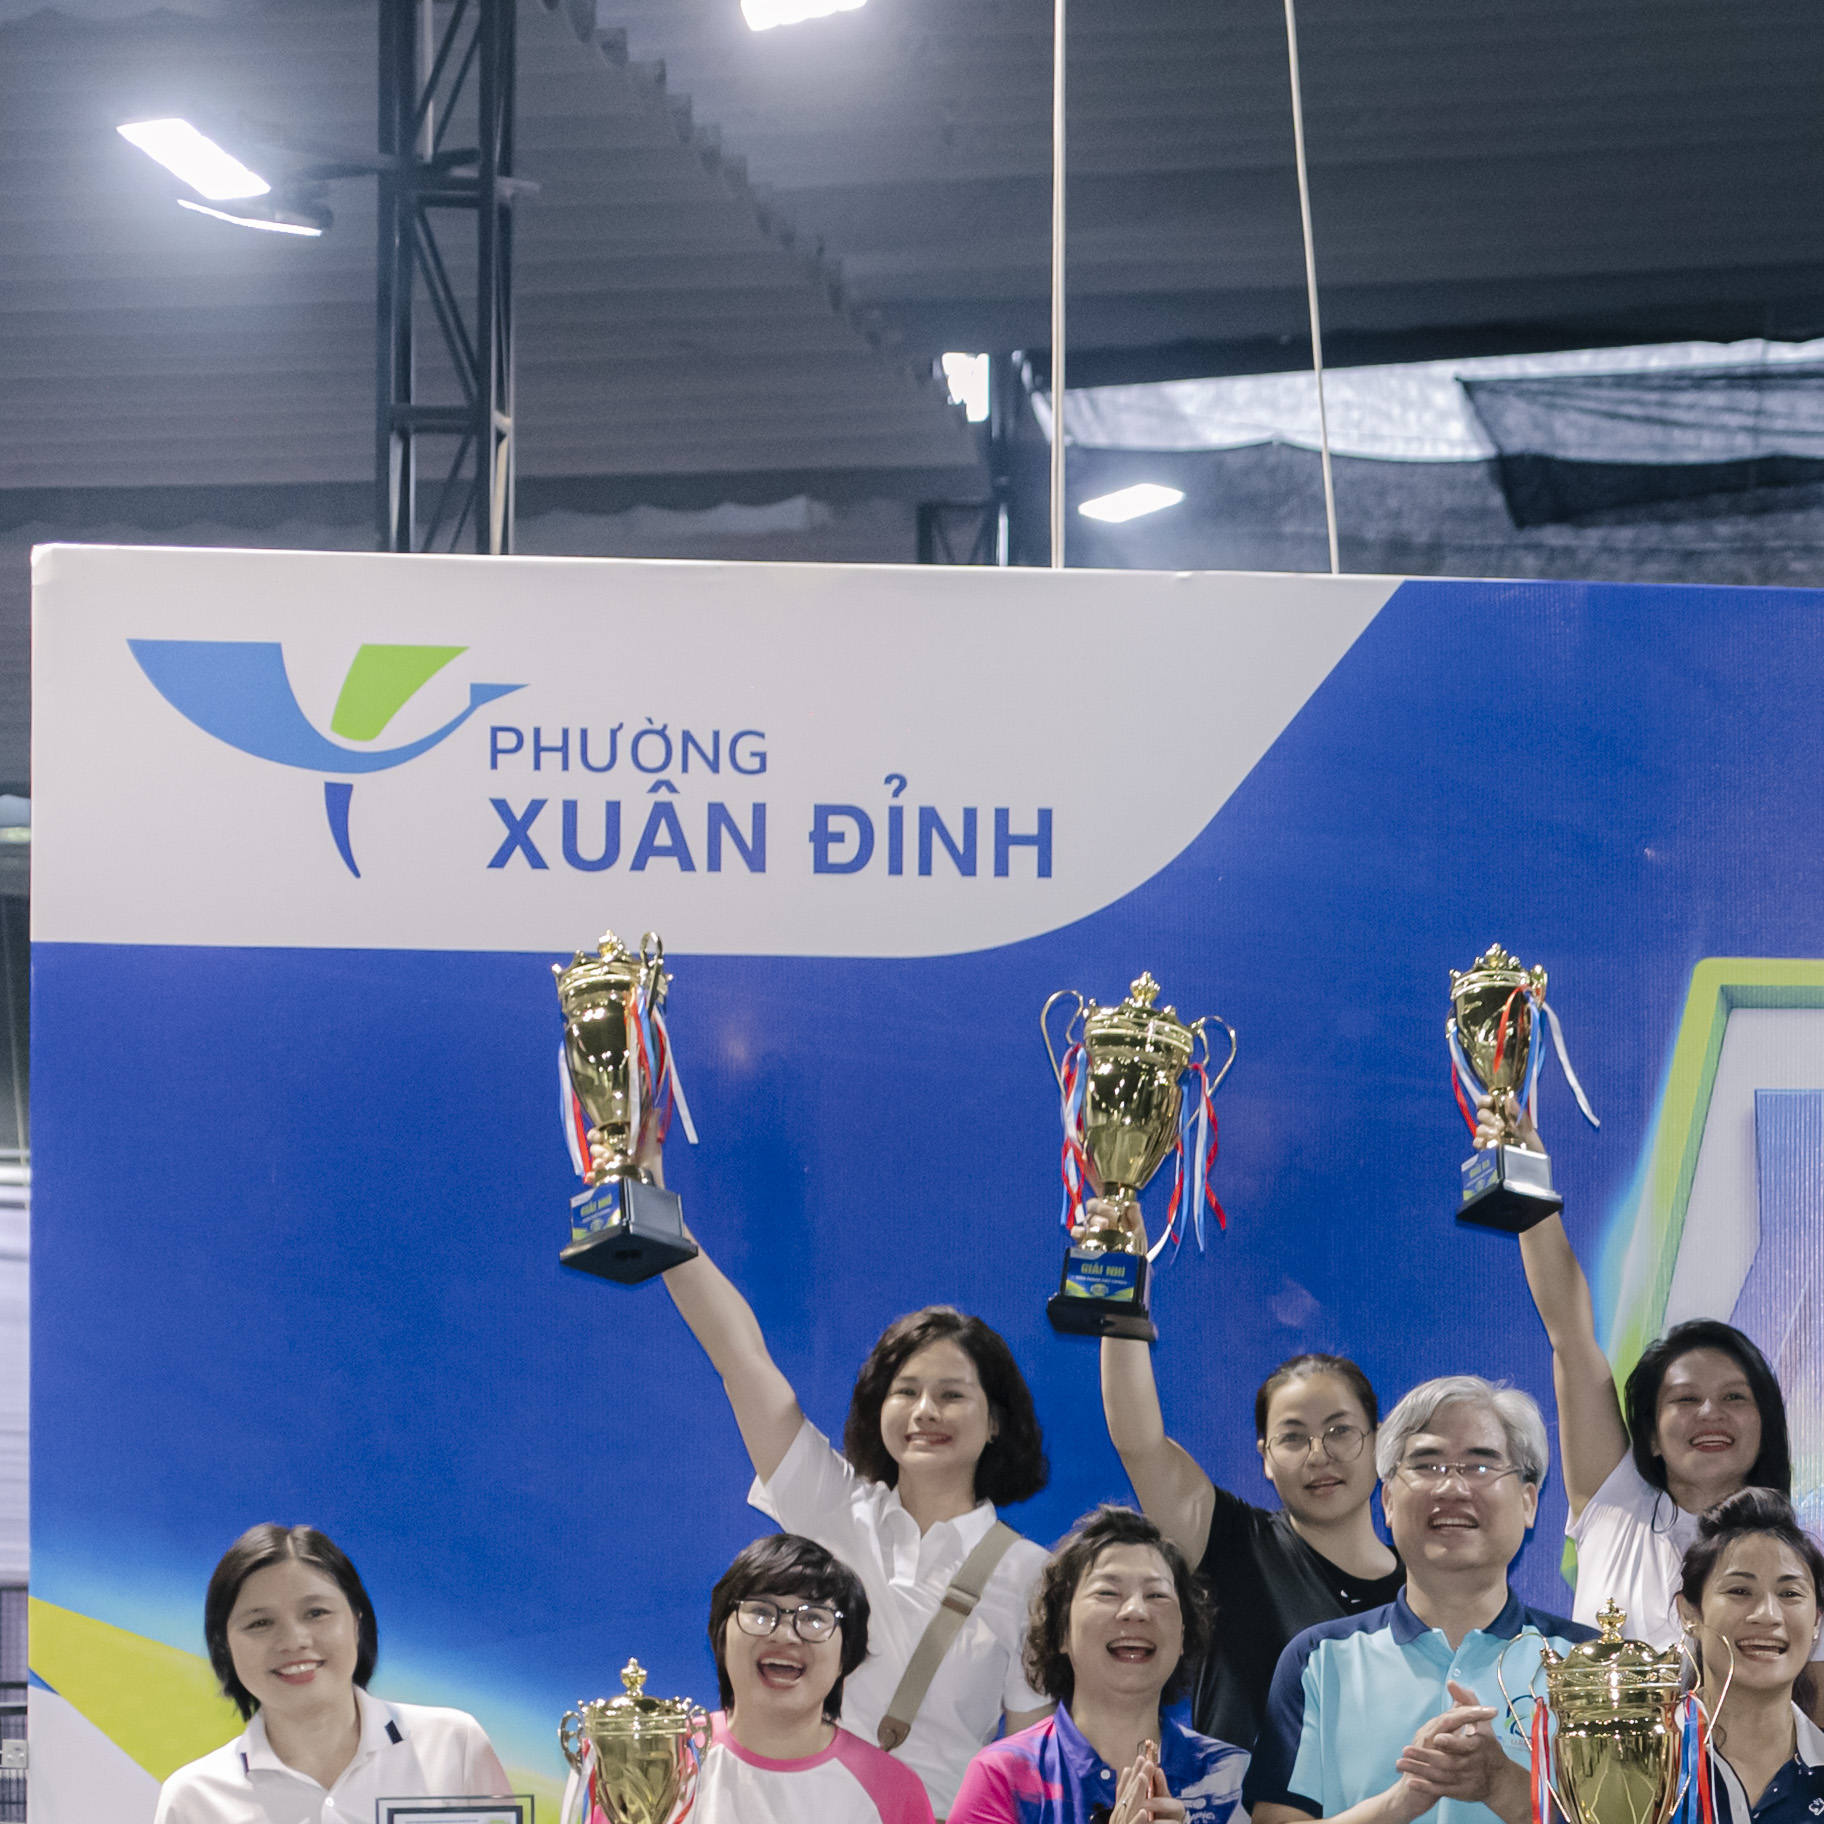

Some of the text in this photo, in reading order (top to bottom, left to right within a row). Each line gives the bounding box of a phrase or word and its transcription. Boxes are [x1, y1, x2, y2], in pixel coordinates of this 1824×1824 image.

[488, 714, 770, 775] PHƯỜNG
[487, 773, 1055, 879] XUÂN ĐỈNH
